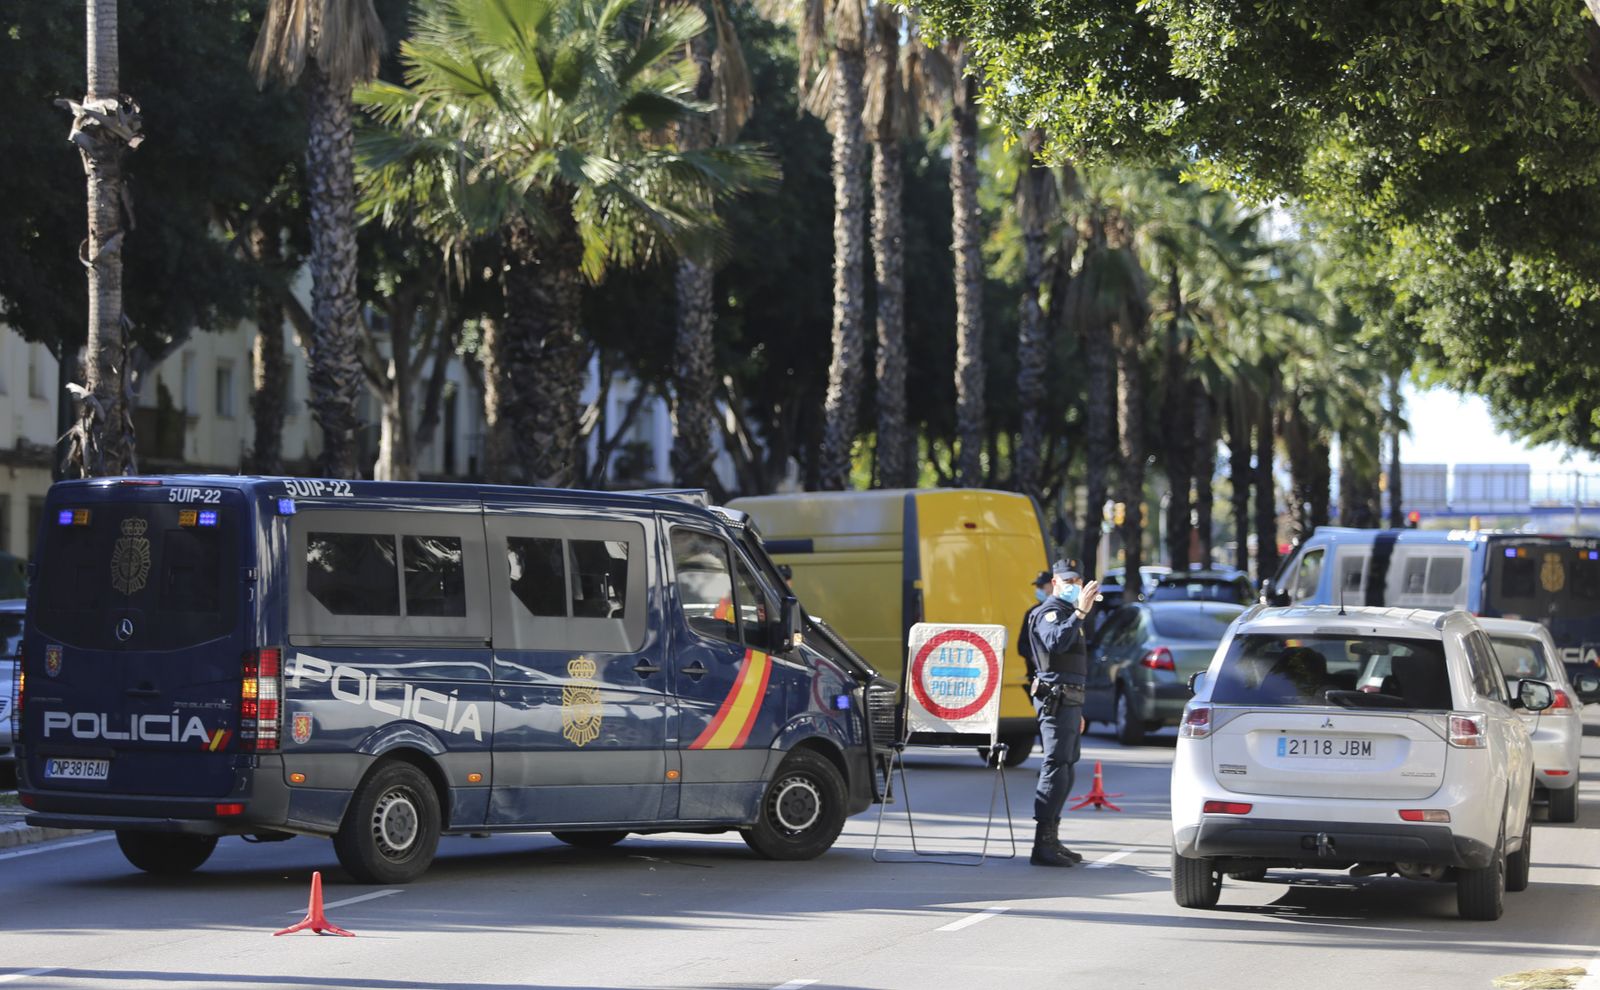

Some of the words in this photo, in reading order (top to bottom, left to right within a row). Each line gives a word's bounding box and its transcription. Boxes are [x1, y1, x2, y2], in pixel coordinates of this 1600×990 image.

[168, 488, 222, 504] 5UIP-22
[283, 480, 355, 497] 5UIP-22
[939, 647, 974, 664] ALTO
[1556, 645, 1599, 664] ICÍA
[292, 652, 482, 742] POLICÍA
[43, 709, 211, 743] POLICÍA
[1289, 739, 1333, 755] 2118
[1339, 740, 1372, 756] JBM
[50, 760, 108, 777] CNP3816AU
